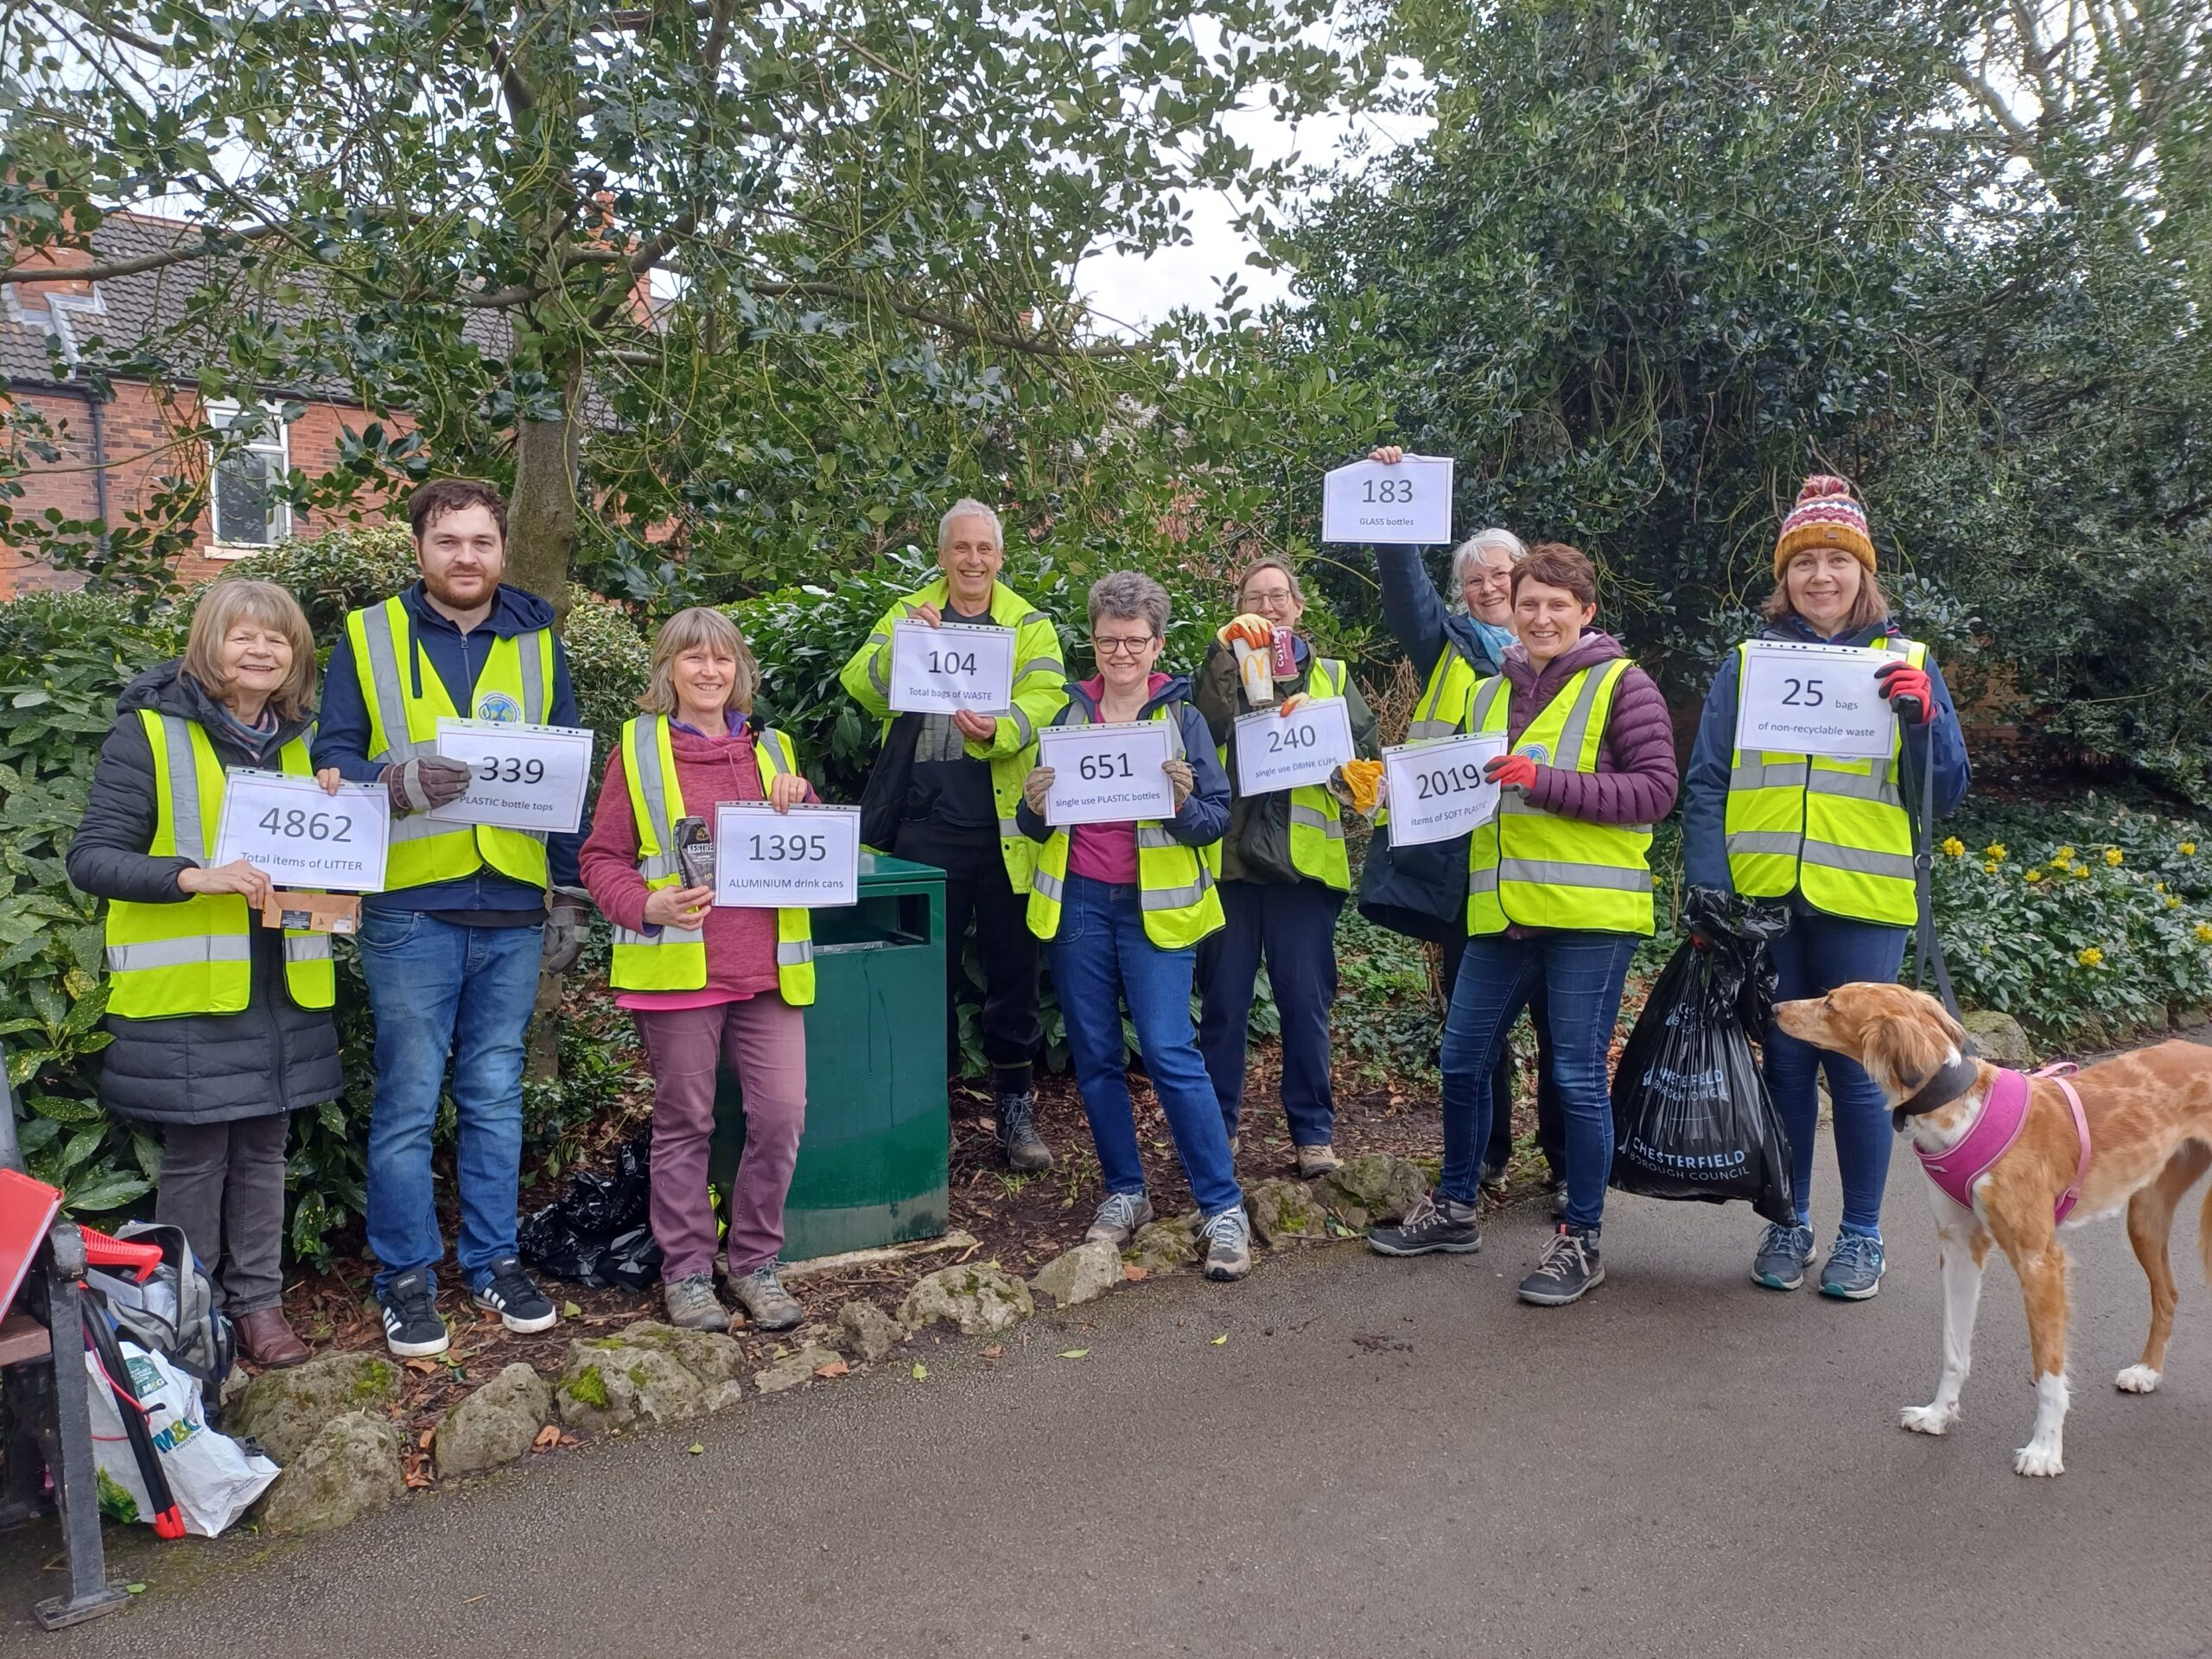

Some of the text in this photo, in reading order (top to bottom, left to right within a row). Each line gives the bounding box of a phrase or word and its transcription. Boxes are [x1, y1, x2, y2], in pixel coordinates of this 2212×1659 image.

[1362, 480, 1414, 504] 183
[1359, 518, 1414, 526] GLASS bottles
[928, 651, 977, 676] 104
[909, 687, 993, 701] Total bags of WASTE
[1782, 678, 1858, 710] 25 bags
[1267, 725, 1316, 753] 240
[1758, 721, 1876, 737] of non-recyclable waste
[480, 756, 544, 785] 339
[1080, 753, 1134, 780] 651
[1255, 767, 1276, 779] single
[1293, 761, 1316, 771] DRINK
[1318, 757, 1338, 767] CUPS
[1416, 763, 1481, 800] 2019
[460, 795, 553, 812] PLASTIC bottle tops
[1056, 798, 1079, 808] single
[1097, 793, 1130, 804] PLASTIC
[1132, 791, 1160, 802] bottles
[258, 807, 353, 842] 4862
[1411, 800, 1488, 826] items of SOFT PLASTIC
[687, 843, 715, 855] KESTRE
[749, 835, 826, 861] 1395
[241, 852, 362, 871] Total items of LITTER
[728, 878, 844, 888] ALUMINIUM drink cans
[1632, 1136, 1745, 1170] CHESTERFIELD
[1630, 1152, 1751, 1181] BOROUGH COUNCIL
[142, 1378, 165, 1394] M&G
